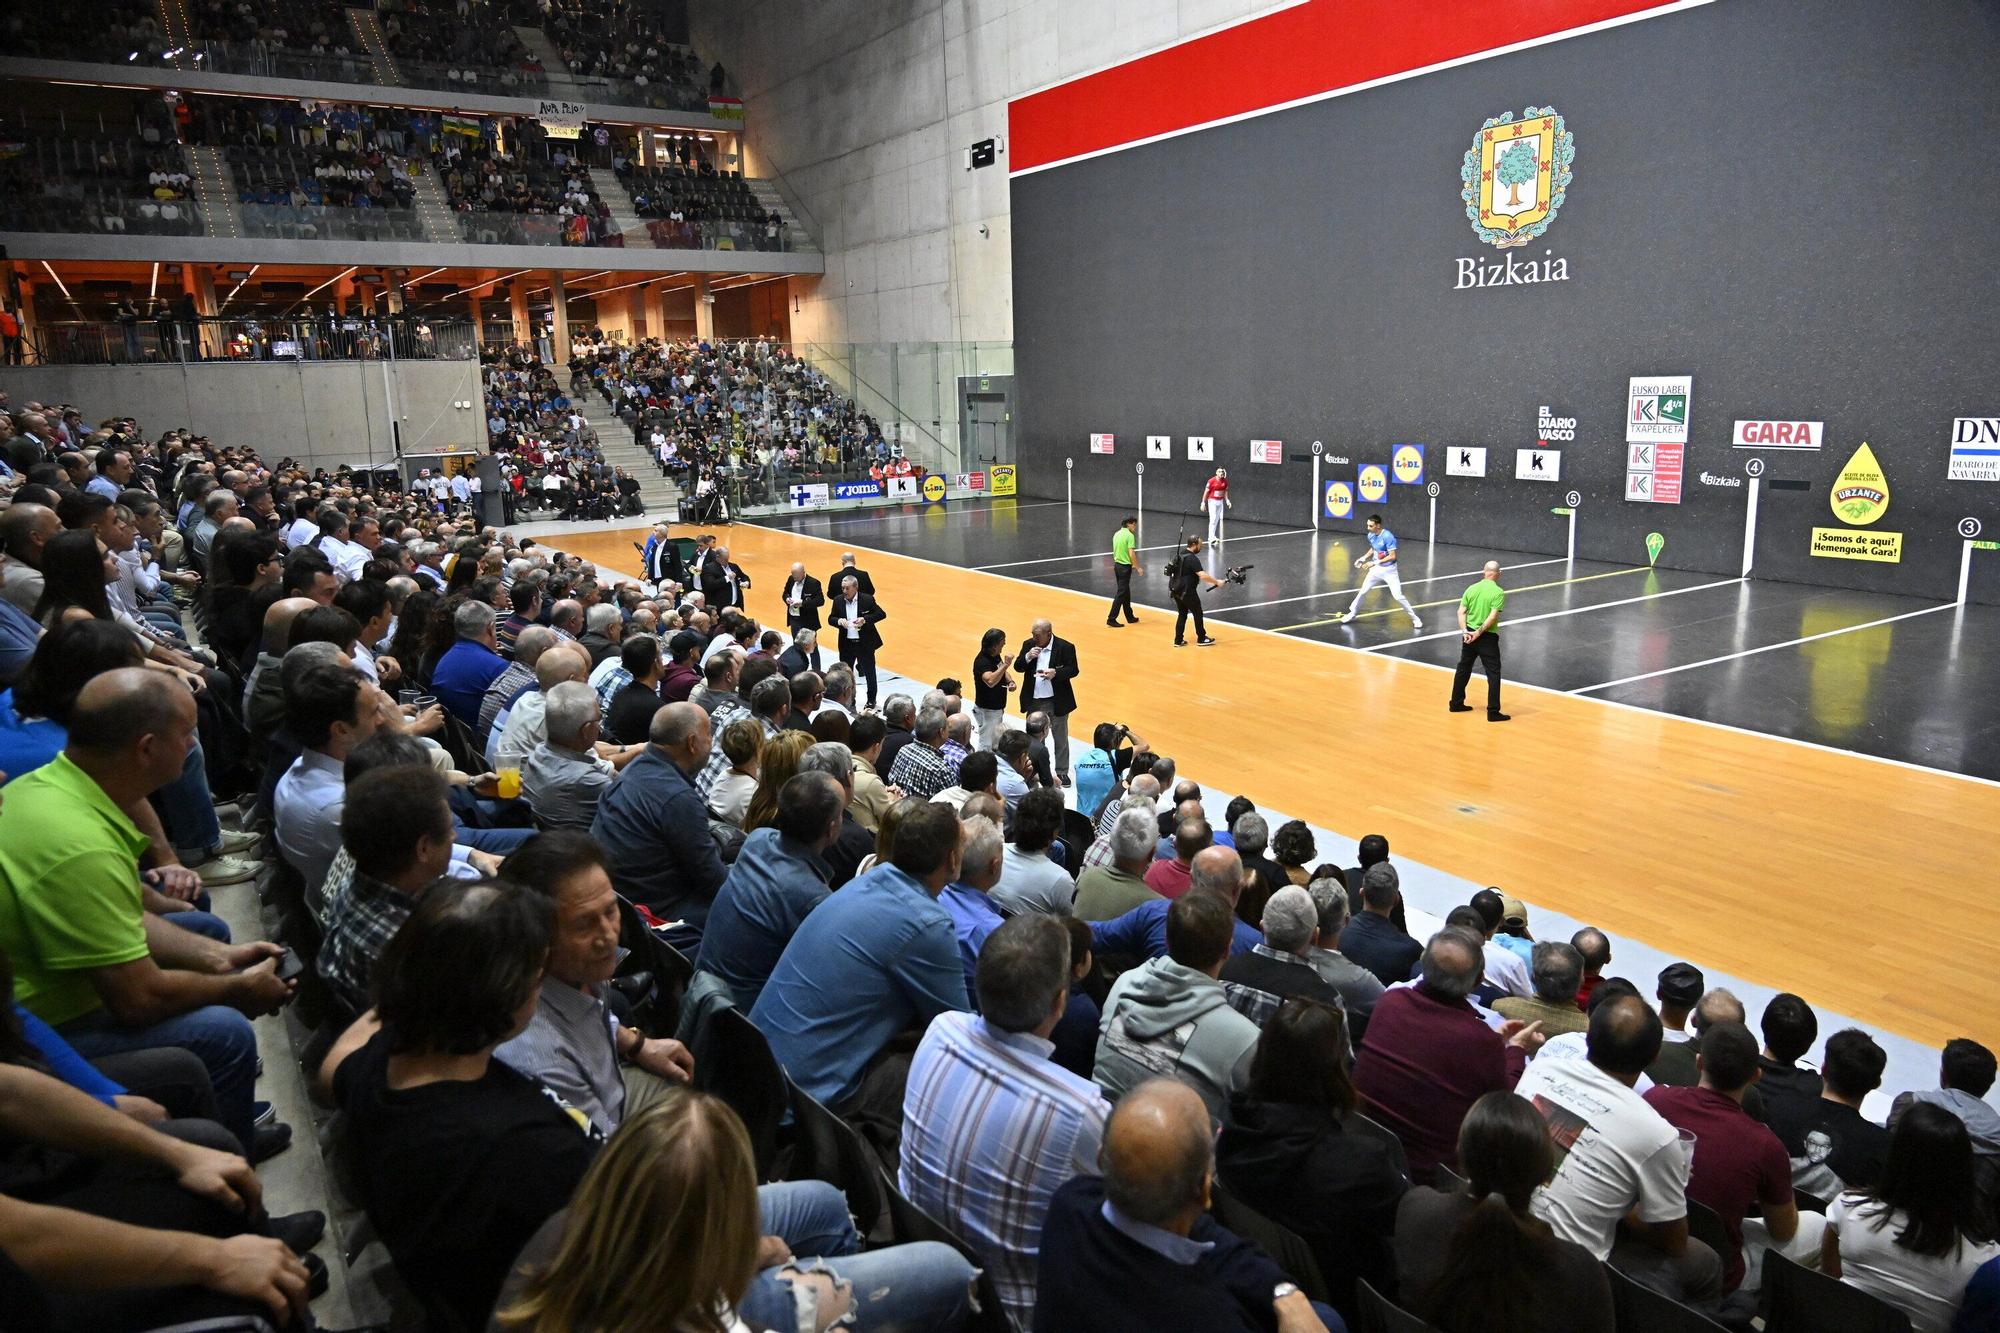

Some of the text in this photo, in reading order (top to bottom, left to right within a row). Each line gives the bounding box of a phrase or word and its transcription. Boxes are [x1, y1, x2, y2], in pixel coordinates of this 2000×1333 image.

[1453, 249, 1570, 289] Bizkaia
[1632, 385, 1687, 395] EUSKO LABEL
[1538, 406, 1552, 417] EL
[1538, 418, 1577, 430] DIARIO
[1631, 424, 1684, 434] TXAPELKETA
[1538, 429, 1575, 441] VASCO
[1742, 422, 1811, 445] GARA
[1955, 419, 2000, 443] DN
[1314, 443, 1320, 452] 7
[1396, 457, 1420, 469] LIDL
[1750, 462, 1759, 473] 4
[1952, 460, 1998, 469] DIARIO DE
[1951, 469, 1997, 480] NAVARRA
[1361, 476, 1383, 488] LIDL
[1705, 475, 1740, 487] Bizkaia
[925, 483, 944, 492] LIDL
[1430, 485, 1437, 494] 6
[1328, 493, 1350, 504] LIDL
[1570, 494, 1577, 504] 5
[1838, 488, 1882, 501] URZANTE
[1964, 521, 1975, 534] 3
[1818, 533, 1853, 543] ¡Somos
[1856, 535, 1867, 544] de
[1814, 543, 1897, 557] Hemengoak Gara!
[1971, 540, 1997, 550] FALTA
